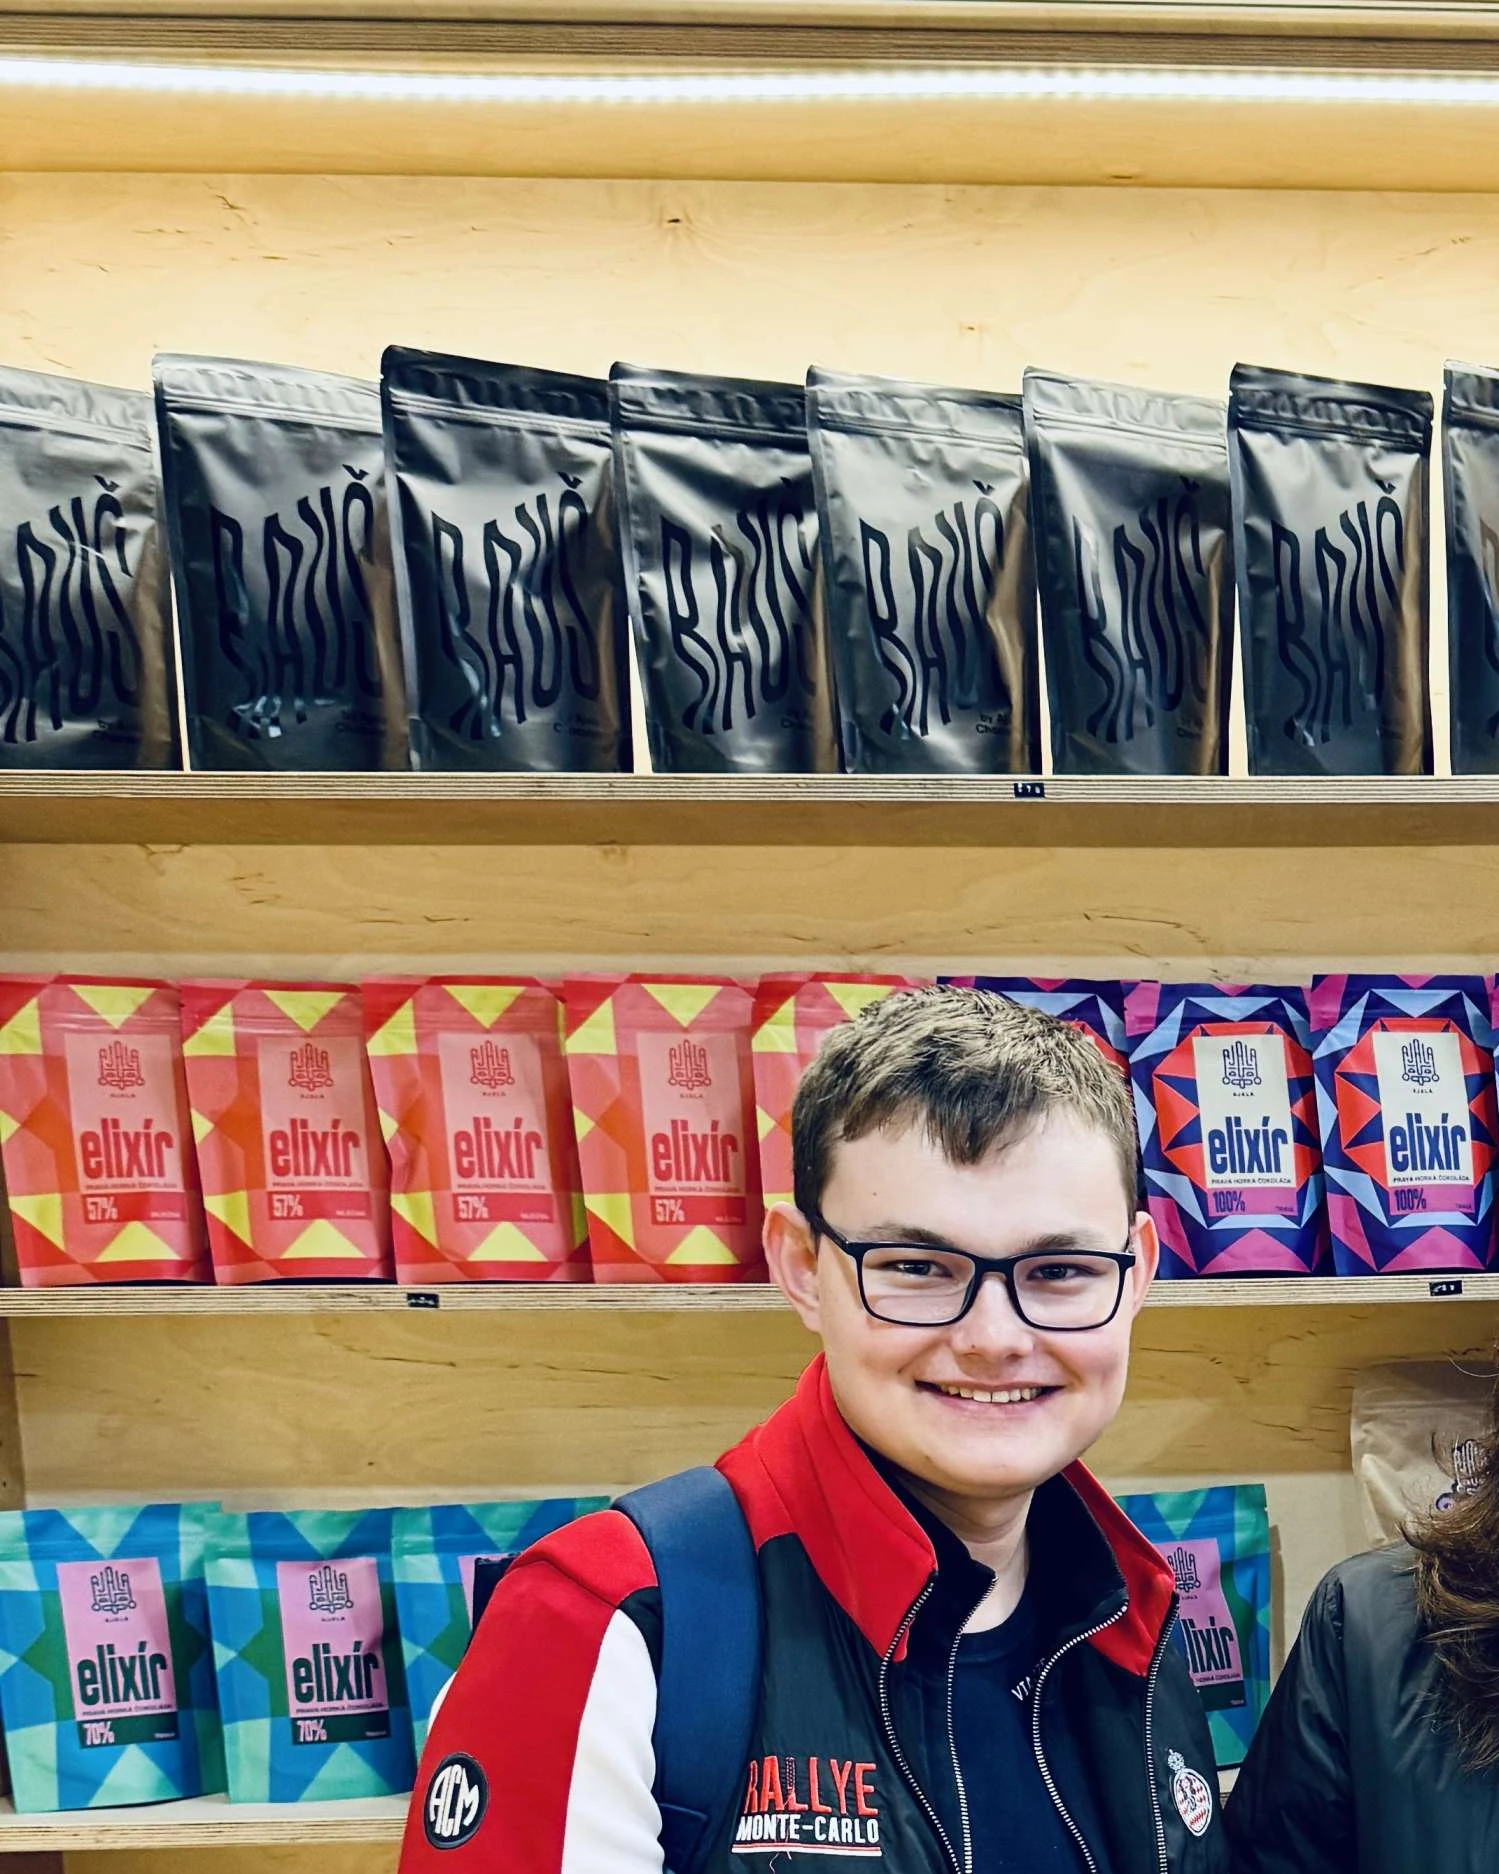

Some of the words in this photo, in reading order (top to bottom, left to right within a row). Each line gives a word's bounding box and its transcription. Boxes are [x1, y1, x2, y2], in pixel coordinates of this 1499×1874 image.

[0, 475, 142, 743] AUŠ
[81, 1119, 174, 1179] elixír
[270, 1119, 360, 1178] elixír
[454, 1117, 543, 1179] elixír
[652, 1119, 738, 1182] elixír
[1208, 1116, 1288, 1174] elixír
[1389, 1113, 1466, 1172] elixír
[86, 1196, 118, 1221] 57%
[272, 1194, 304, 1217] 57%
[457, 1196, 489, 1219] 57%
[655, 1199, 685, 1222] 57%
[1213, 1191, 1246, 1212] 100%
[1395, 1188, 1427, 1211] 100%
[77, 1641, 167, 1706] elixír
[293, 1641, 379, 1704] elixír
[1181, 1616, 1234, 1673] lixír
[83, 1721, 115, 1745] 70%
[297, 1719, 327, 1742] 70%
[429, 1764, 480, 1837] ACM
[744, 1756, 879, 1816] RALLYE
[736, 1813, 880, 1844] MONTE-CARLO
